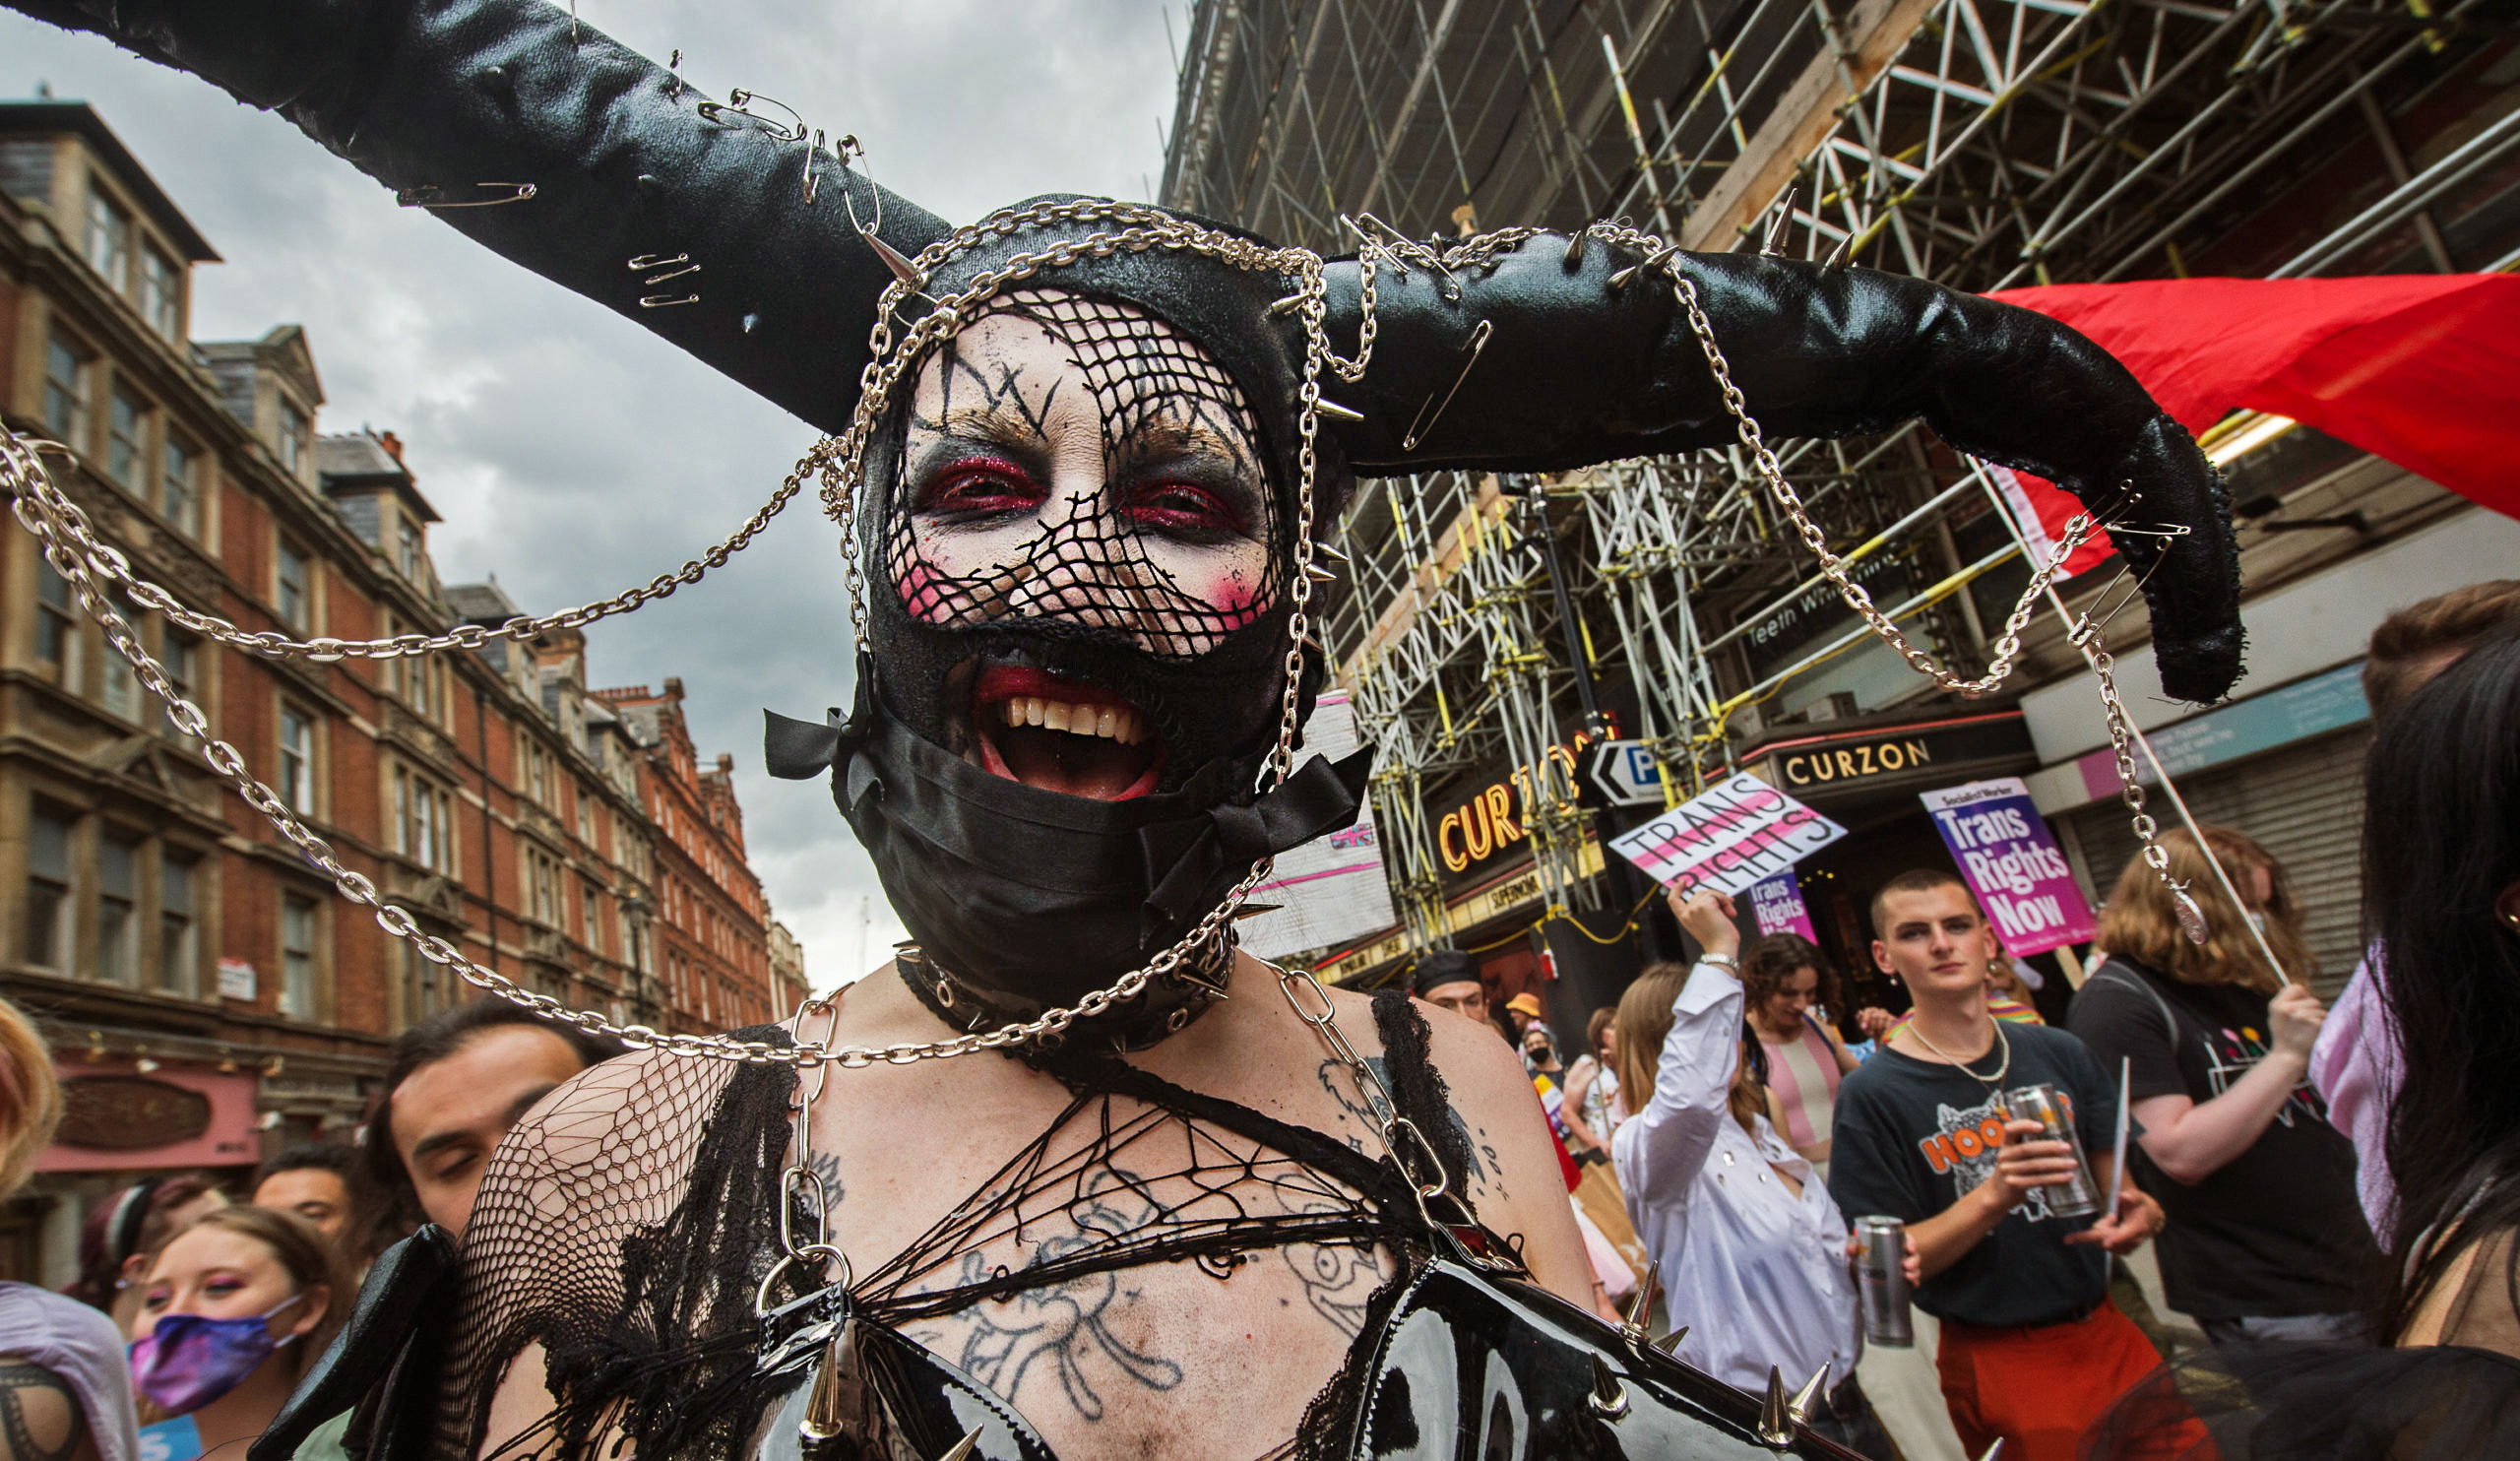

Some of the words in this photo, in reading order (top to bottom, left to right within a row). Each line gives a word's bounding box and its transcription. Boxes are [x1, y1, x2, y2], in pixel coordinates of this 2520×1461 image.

[1632, 748, 1657, 783] P
[1786, 738, 1931, 785] CURZON
[1619, 778, 1787, 866] TRANS
[1935, 807, 2031, 850] Trans
[1673, 809, 1832, 895] RIGHTS
[1964, 840, 2069, 896] Rights
[1755, 897, 1804, 927] Rights
[1986, 893, 2066, 938] Now
